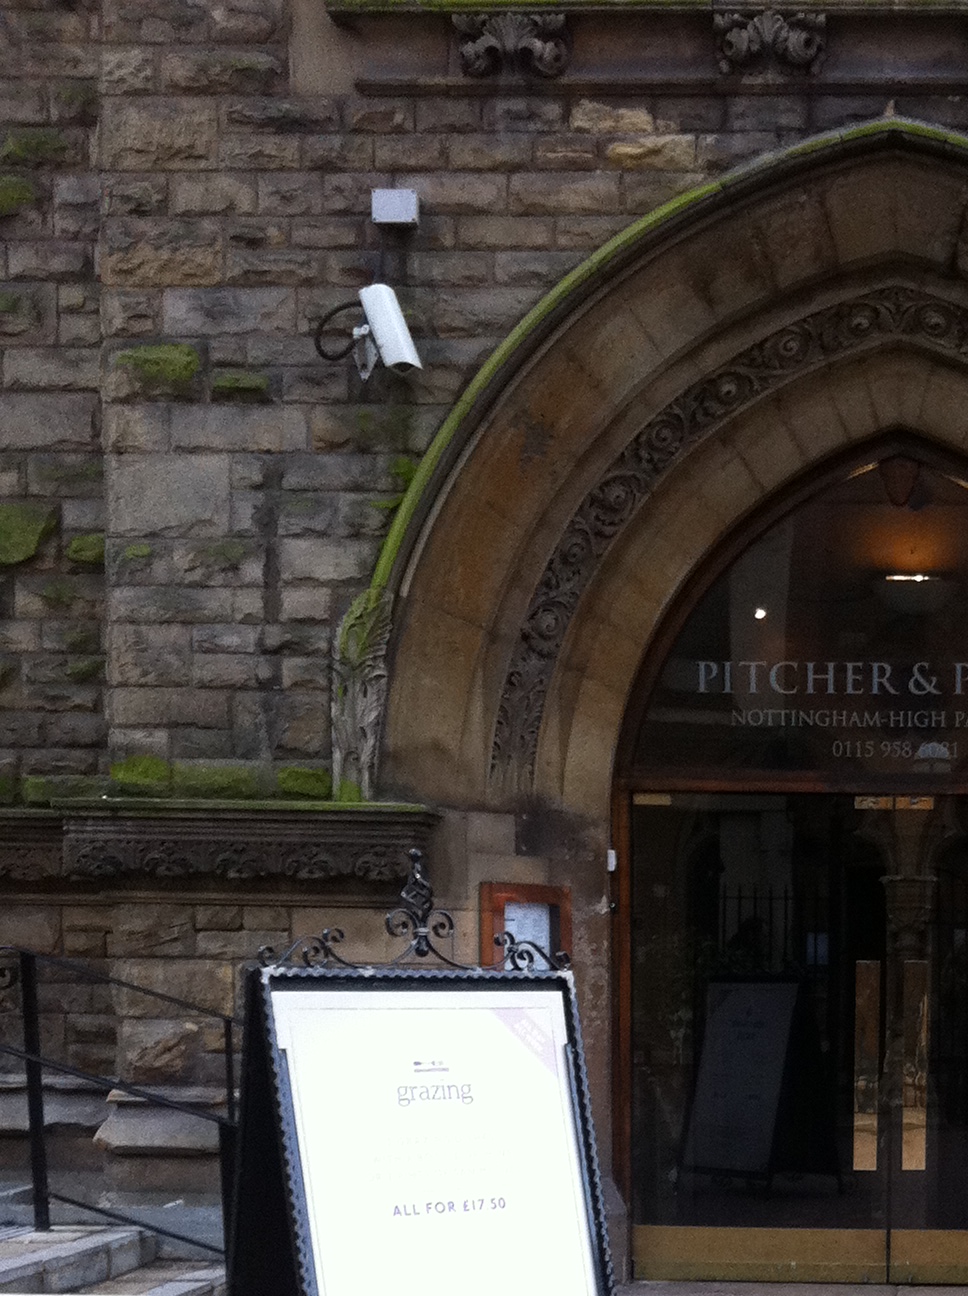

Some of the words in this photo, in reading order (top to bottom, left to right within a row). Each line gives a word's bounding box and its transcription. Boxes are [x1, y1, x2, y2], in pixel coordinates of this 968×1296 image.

[695, 660, 900, 695] PITCHER
[907, 661, 943, 695] &
[832, 740, 875, 758] 0115
[880, 741, 913, 758] 958
[396, 1078, 474, 1107] grazing
[393, 1204, 421, 1217] ALL
[426, 1201, 456, 1214] FOR
